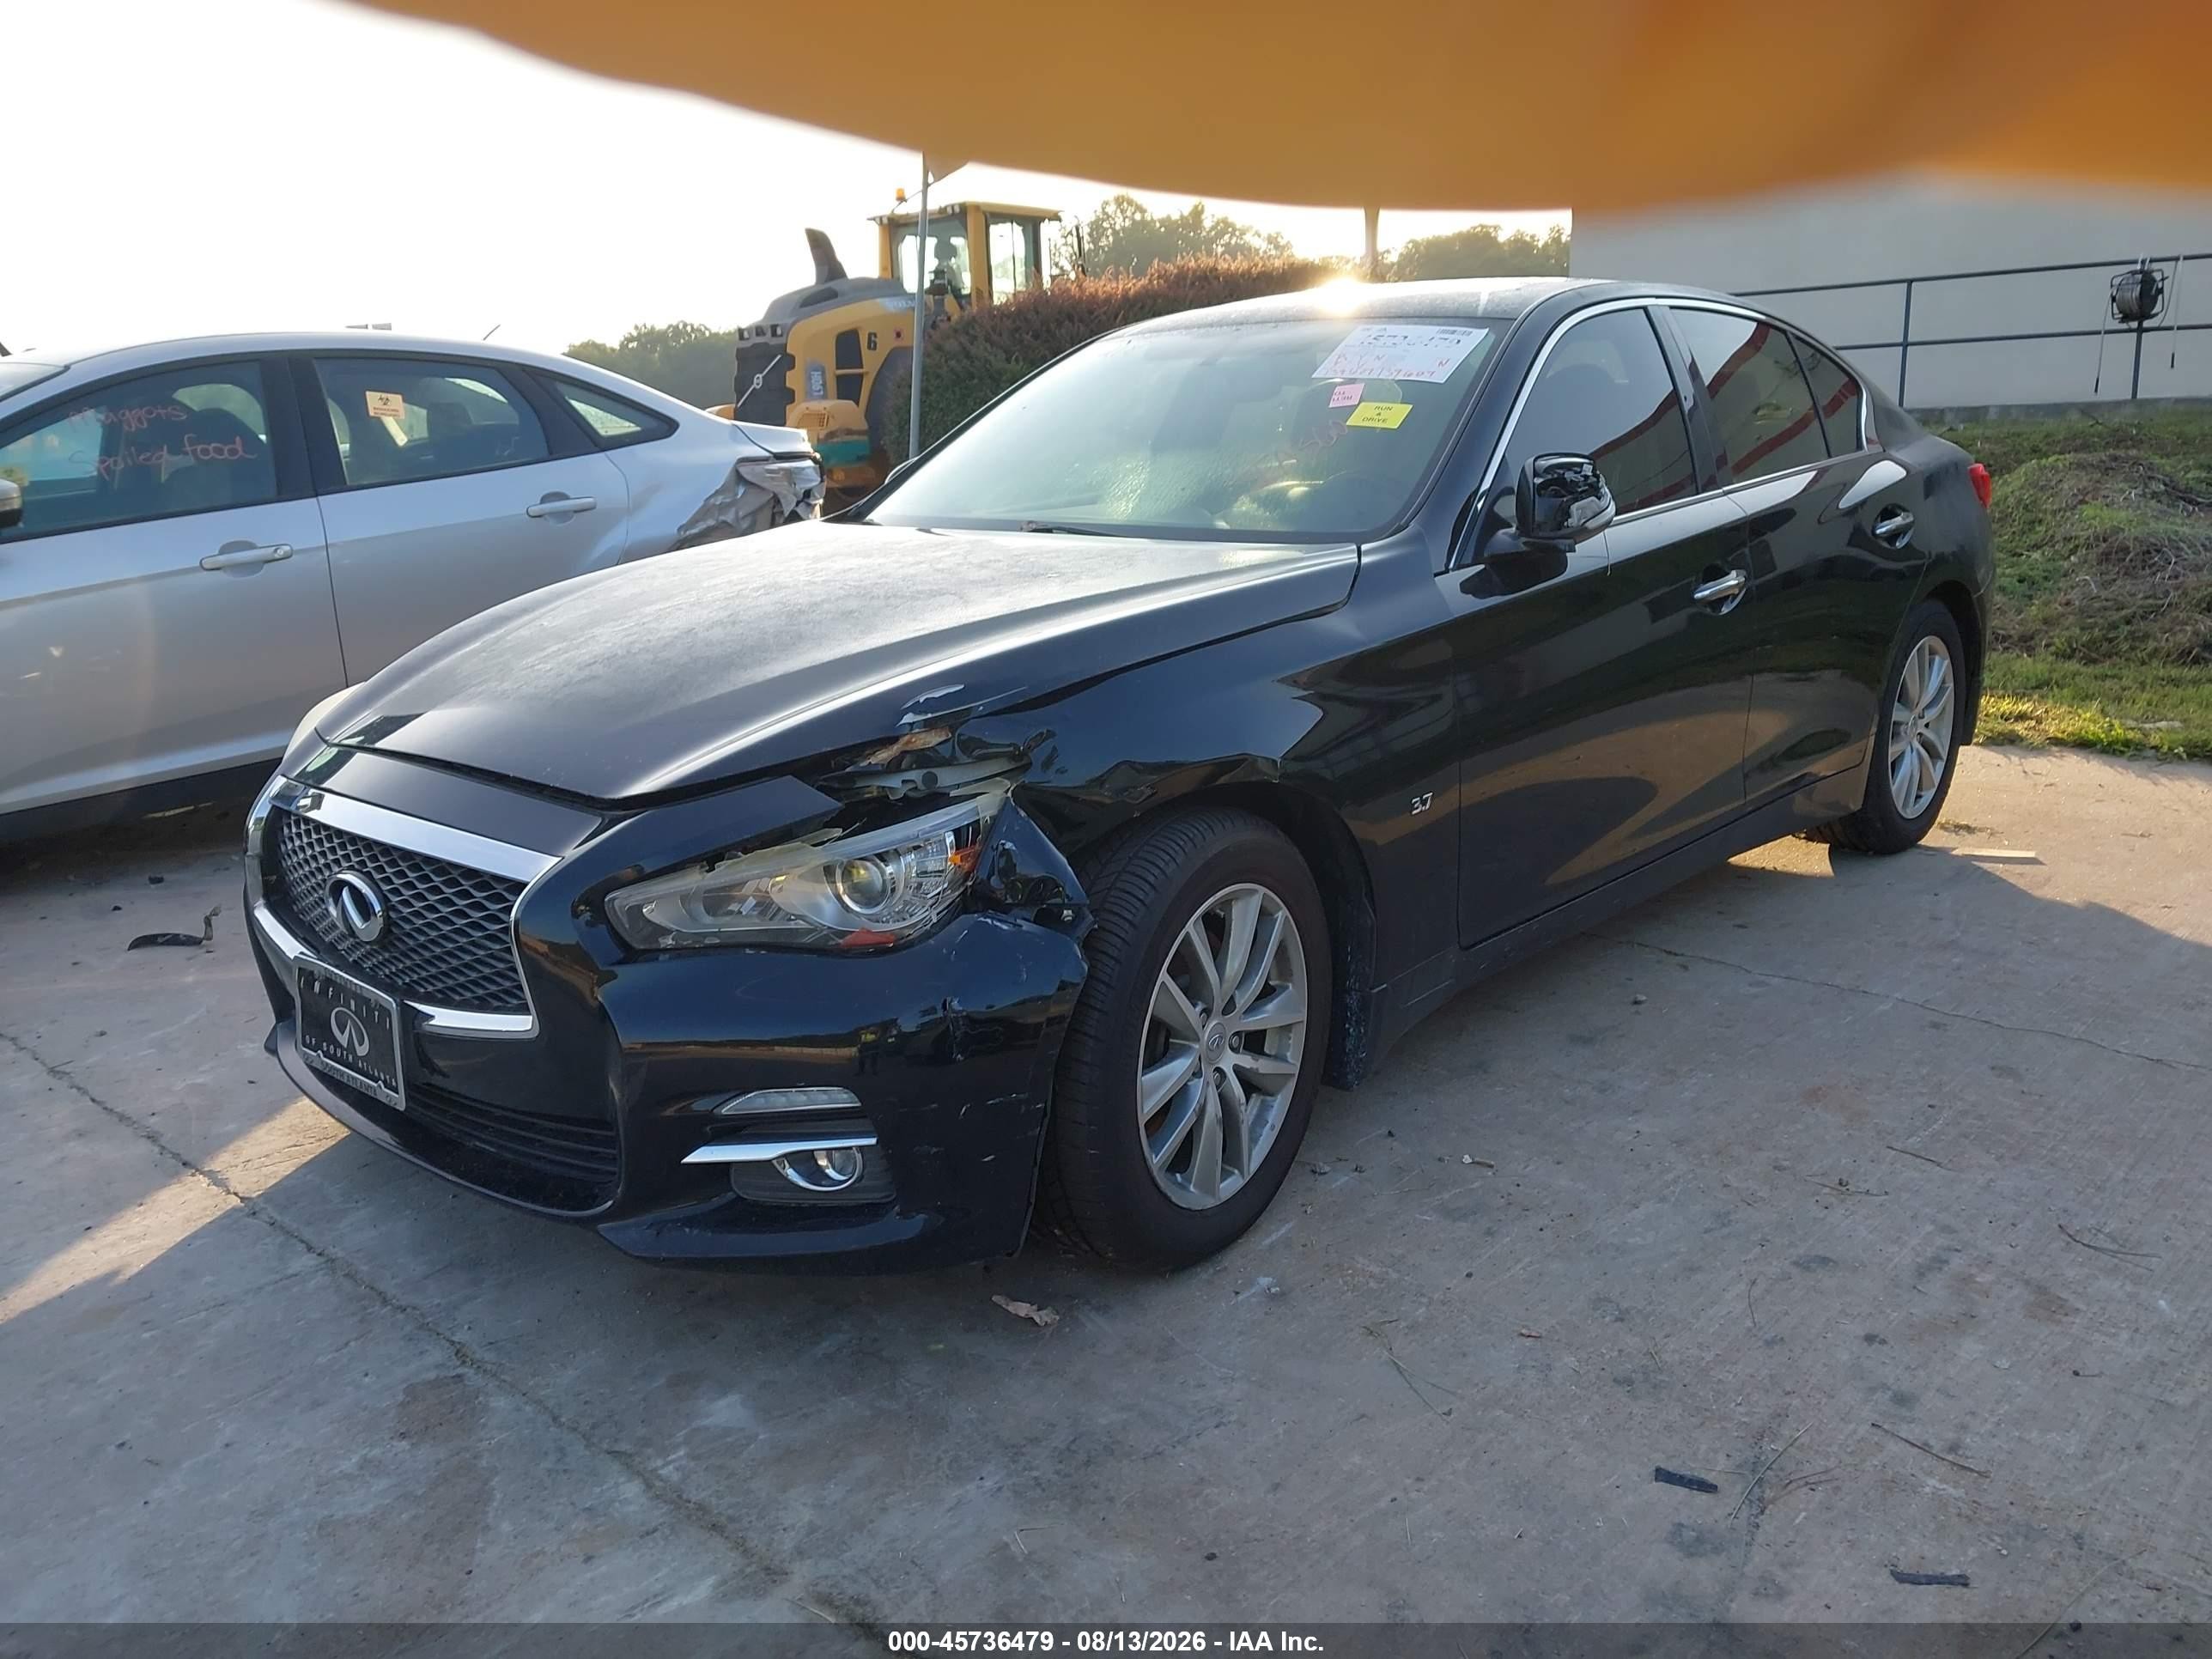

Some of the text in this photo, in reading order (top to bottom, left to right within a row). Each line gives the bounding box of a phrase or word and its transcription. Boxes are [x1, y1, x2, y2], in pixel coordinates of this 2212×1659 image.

[866, 331, 878, 351] 6
[811, 371, 823, 396] L90H
[182, 433, 258, 465] food
[1411, 792, 1433, 815] 3.7
[300, 975, 390, 1030] INFINITI
[305, 1034, 397, 1087] OF SOUTH ATLANTA
